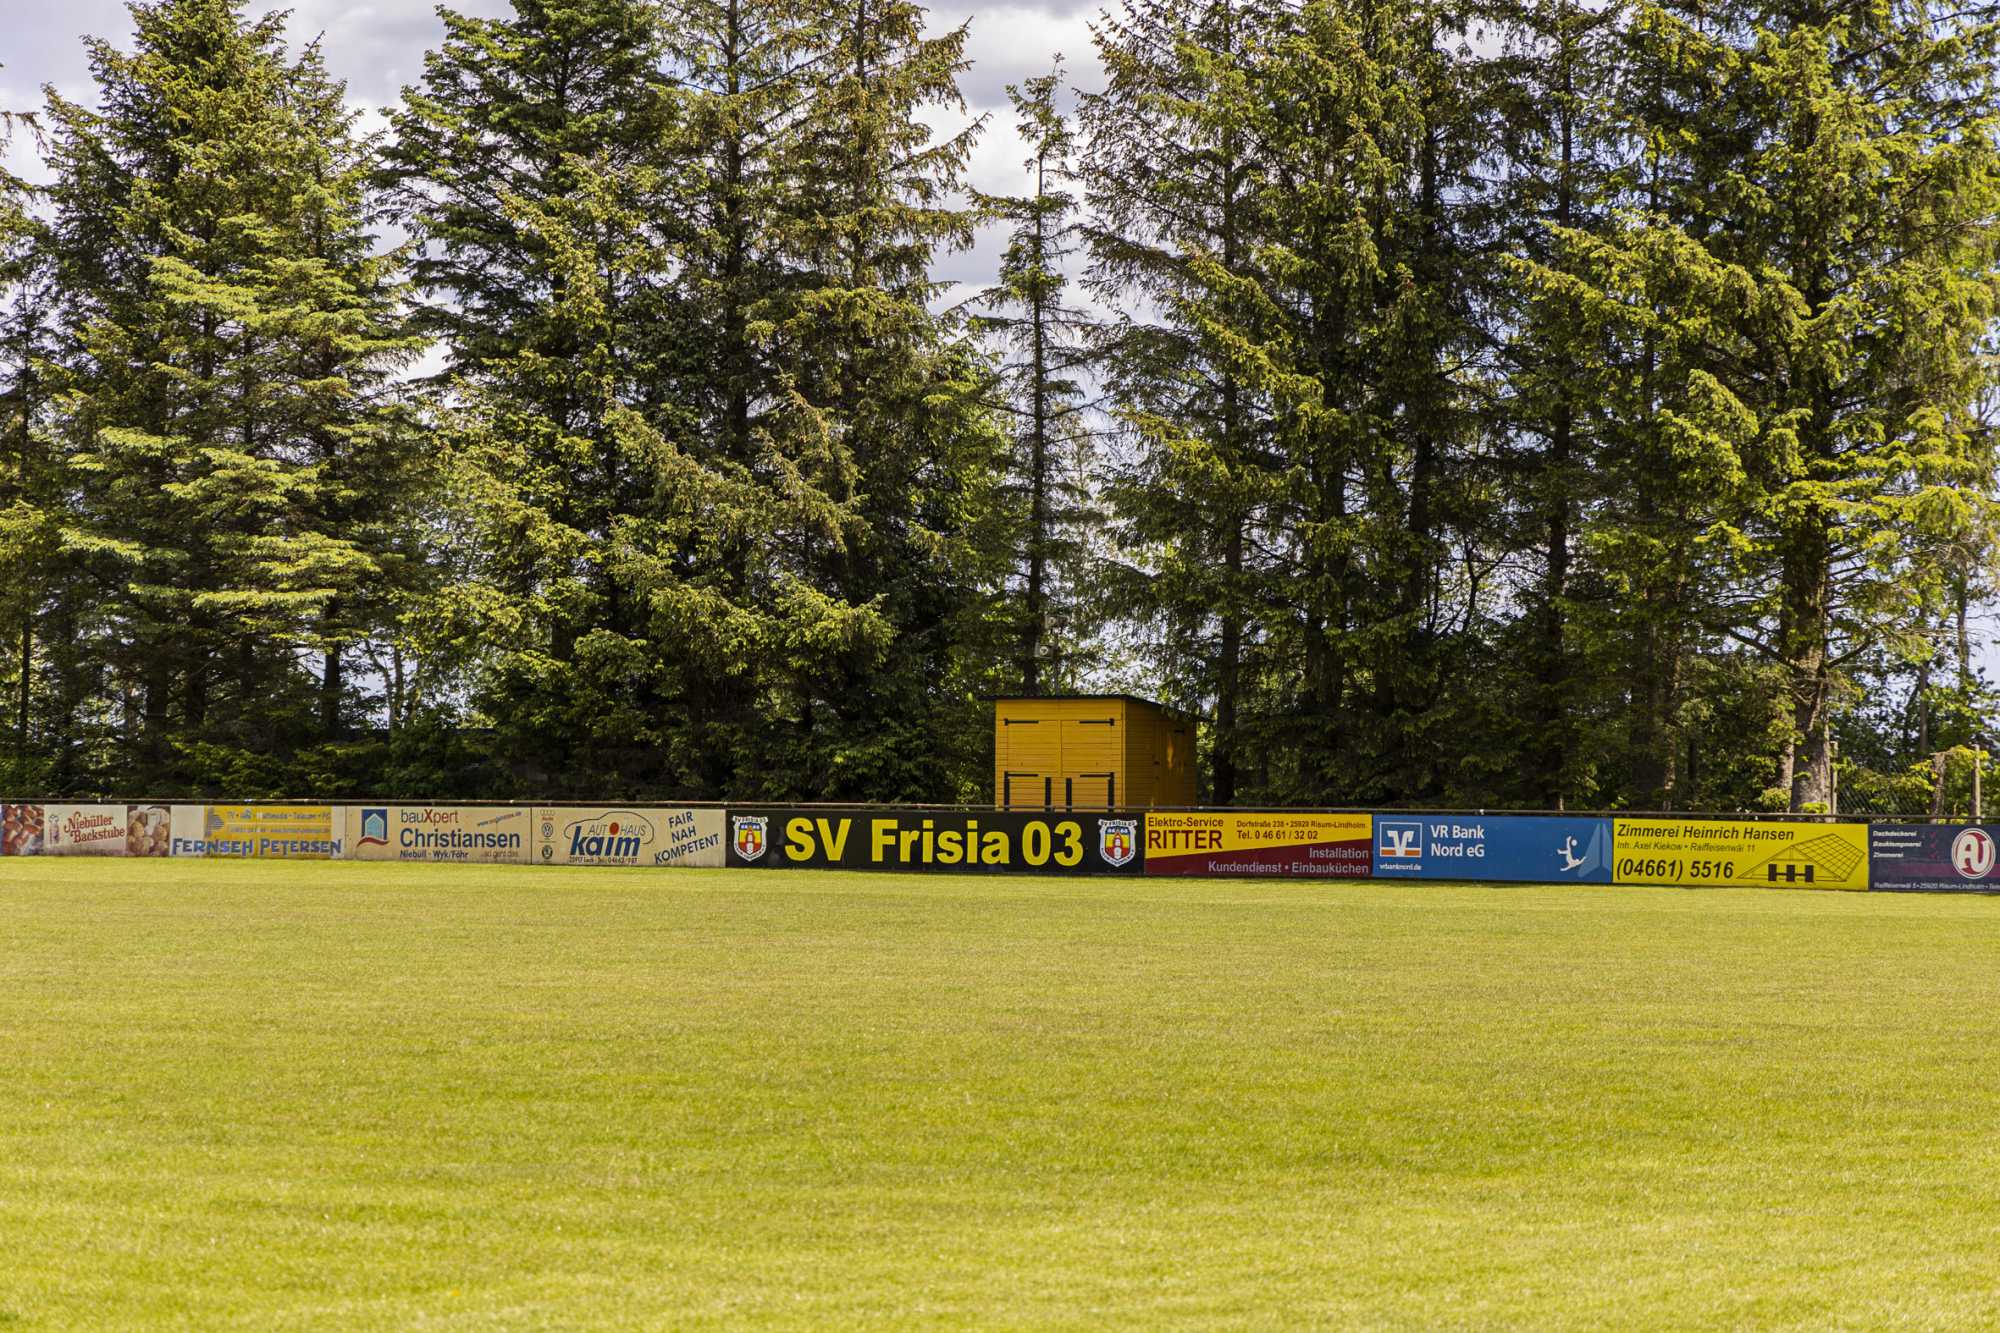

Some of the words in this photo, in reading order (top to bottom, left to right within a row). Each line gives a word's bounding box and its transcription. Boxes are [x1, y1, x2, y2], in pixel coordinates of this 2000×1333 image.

[64, 811, 114, 833] Niebüller
[400, 809, 459, 825] bauXpert
[668, 811, 694, 829] FAIR
[1148, 817, 1224, 827] Elektro-Service
[70, 826, 126, 844] Backstube
[400, 828, 520, 848] Christiansen
[671, 826, 697, 843] NAH
[1148, 830, 1223, 849] RITTER
[1237, 830, 1253, 840] Tel.
[1263, 830, 1274, 840] 46
[1430, 824, 1449, 838] VR
[1452, 825, 1485, 839] Bank
[1617, 824, 1680, 838] Zimmerei
[1683, 825, 1739, 839] Heinrich
[1743, 826, 1795, 841] Hansen
[172, 838, 254, 856] FERNSEH
[260, 838, 342, 856] PETERSEN
[570, 825, 641, 857] kaim
[654, 833, 720, 865] KOMPETENT
[785, 817, 852, 862] SV
[871, 819, 1010, 864] Frisia
[1022, 820, 1084, 867] 03
[1309, 847, 1369, 859] Installation
[1430, 843, 1464, 857] Nord
[1467, 844, 1485, 858] eG
[1208, 861, 1282, 873] Kundendienst
[1291, 862, 1369, 874] Einbauküchen
[1616, 858, 1684, 881] (04661)
[1689, 860, 1734, 879] 5516
